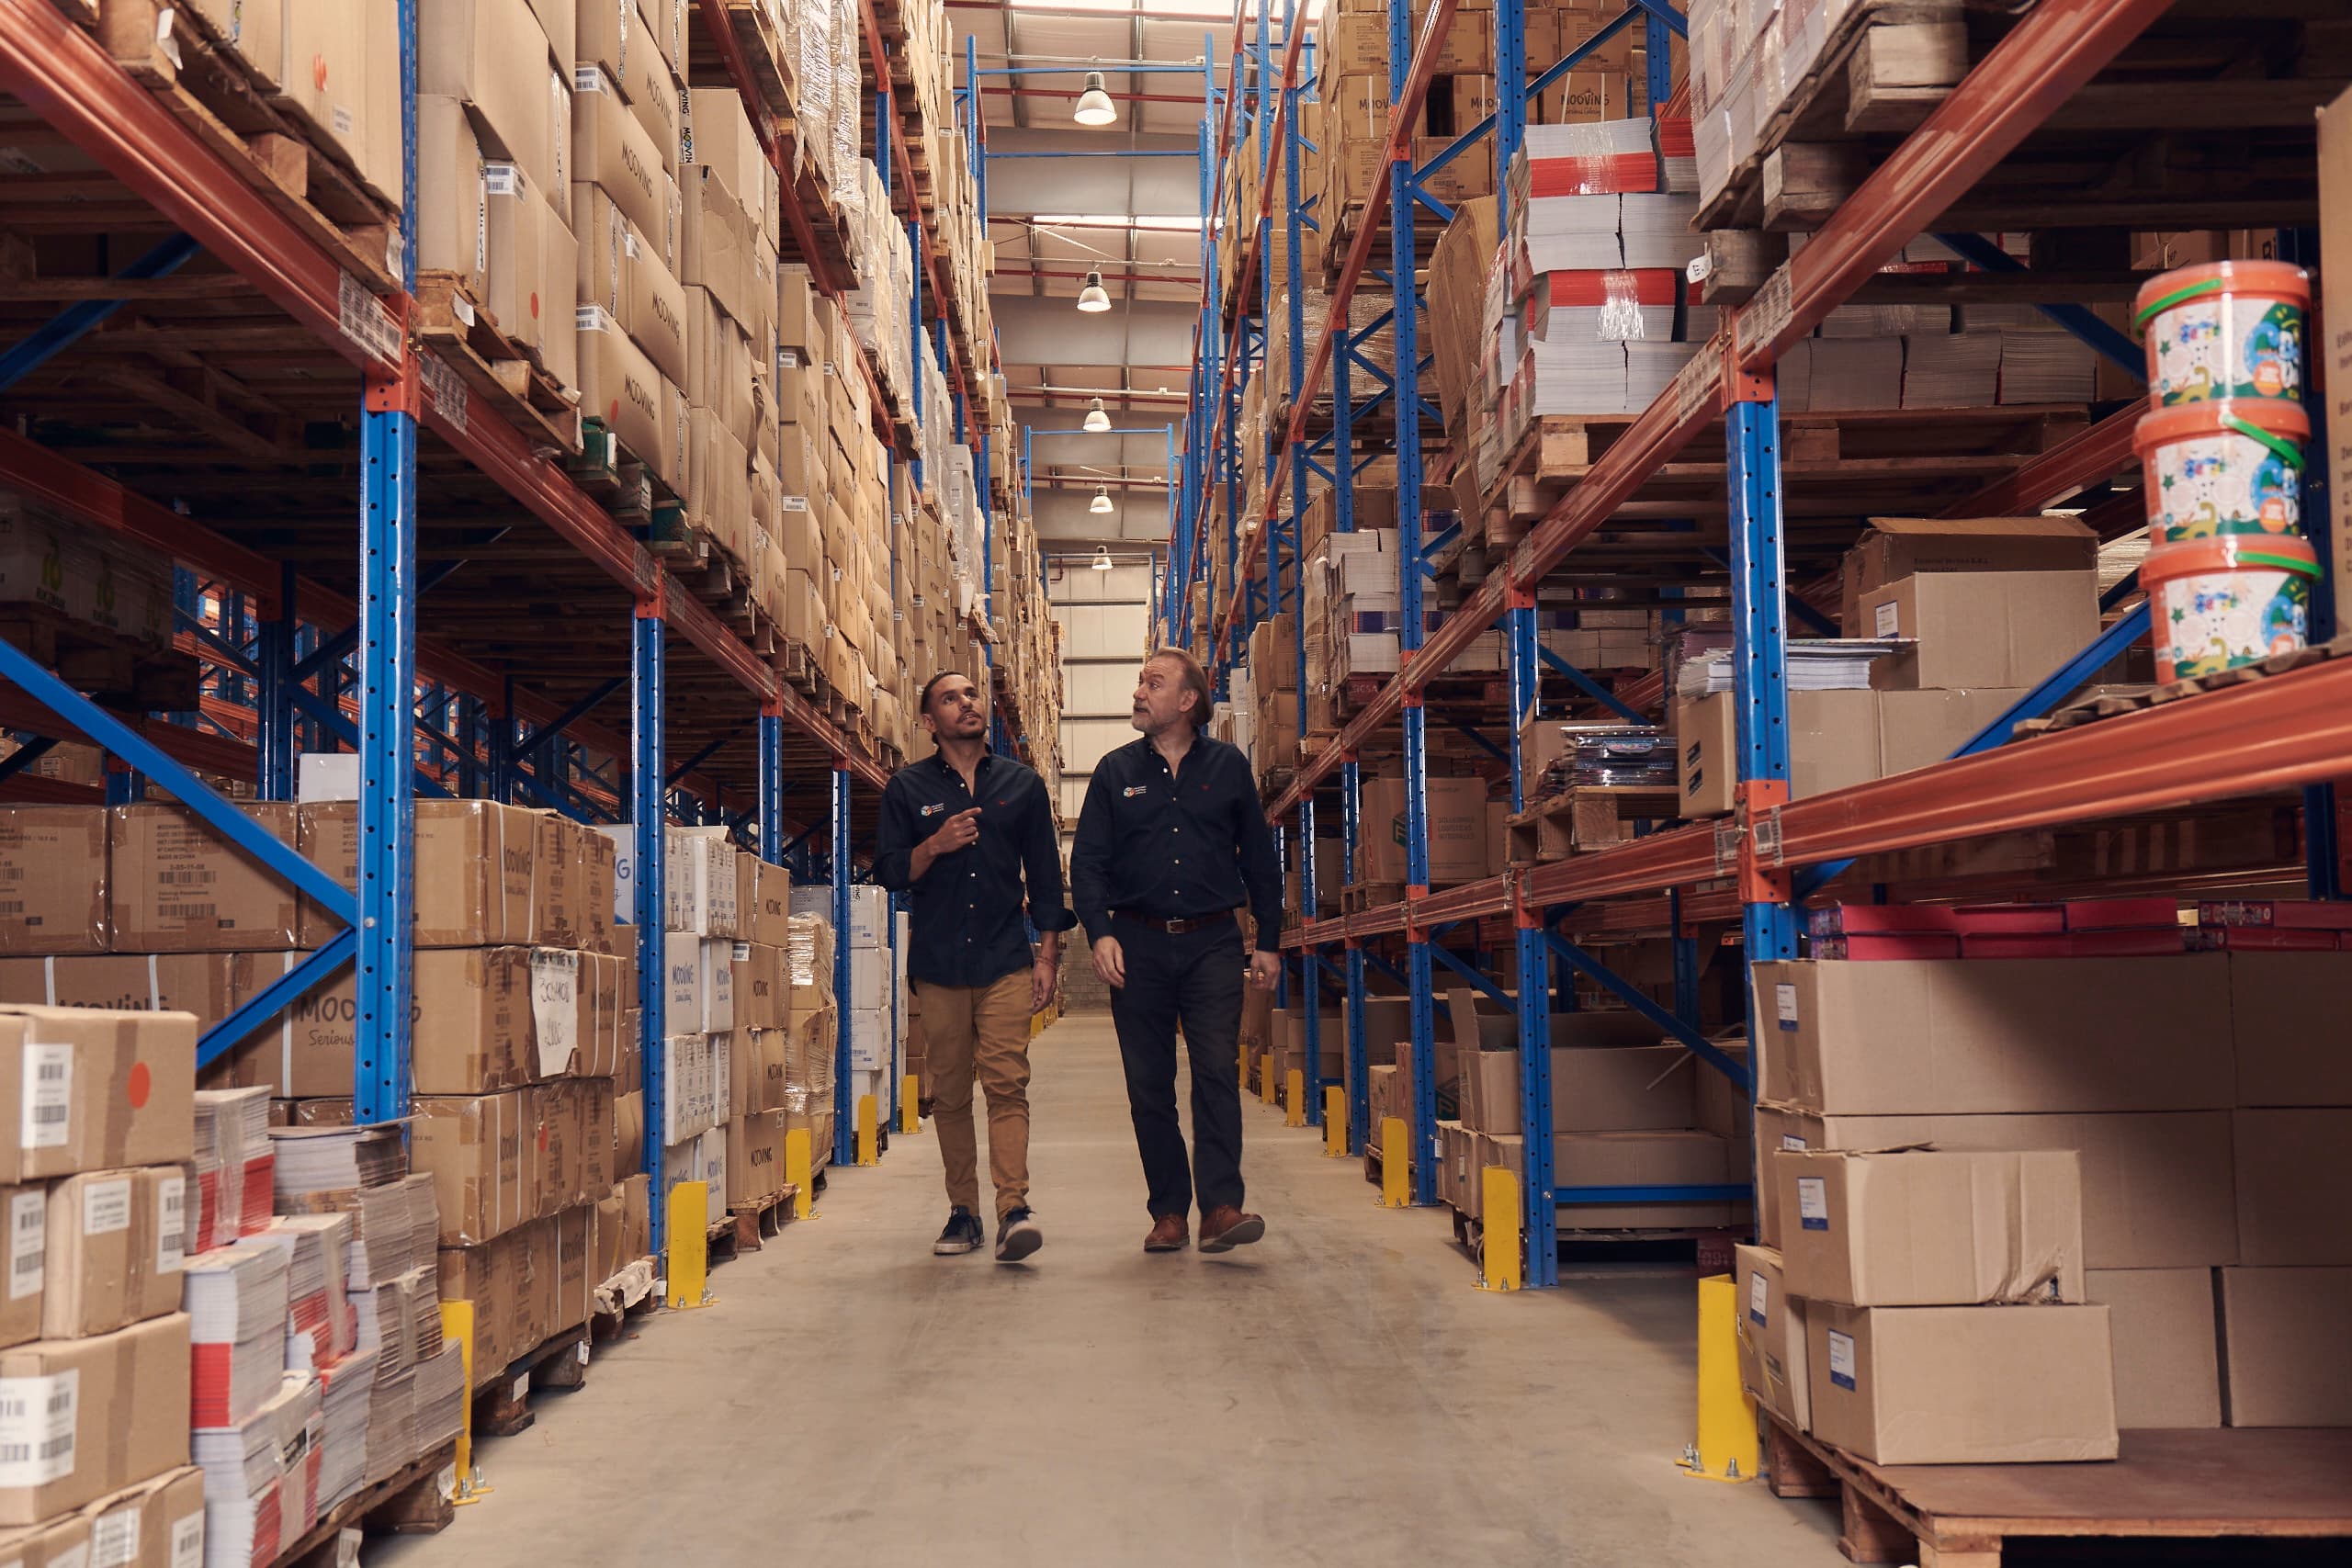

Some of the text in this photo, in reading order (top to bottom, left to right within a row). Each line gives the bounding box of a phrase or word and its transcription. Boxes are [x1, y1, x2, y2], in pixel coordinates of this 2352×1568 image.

[622, 140, 652, 198] MOOVING
[683, 127, 693, 164] MOOVIN
[652, 290, 680, 345] MOOVING
[624, 374, 655, 421] MOOVING
